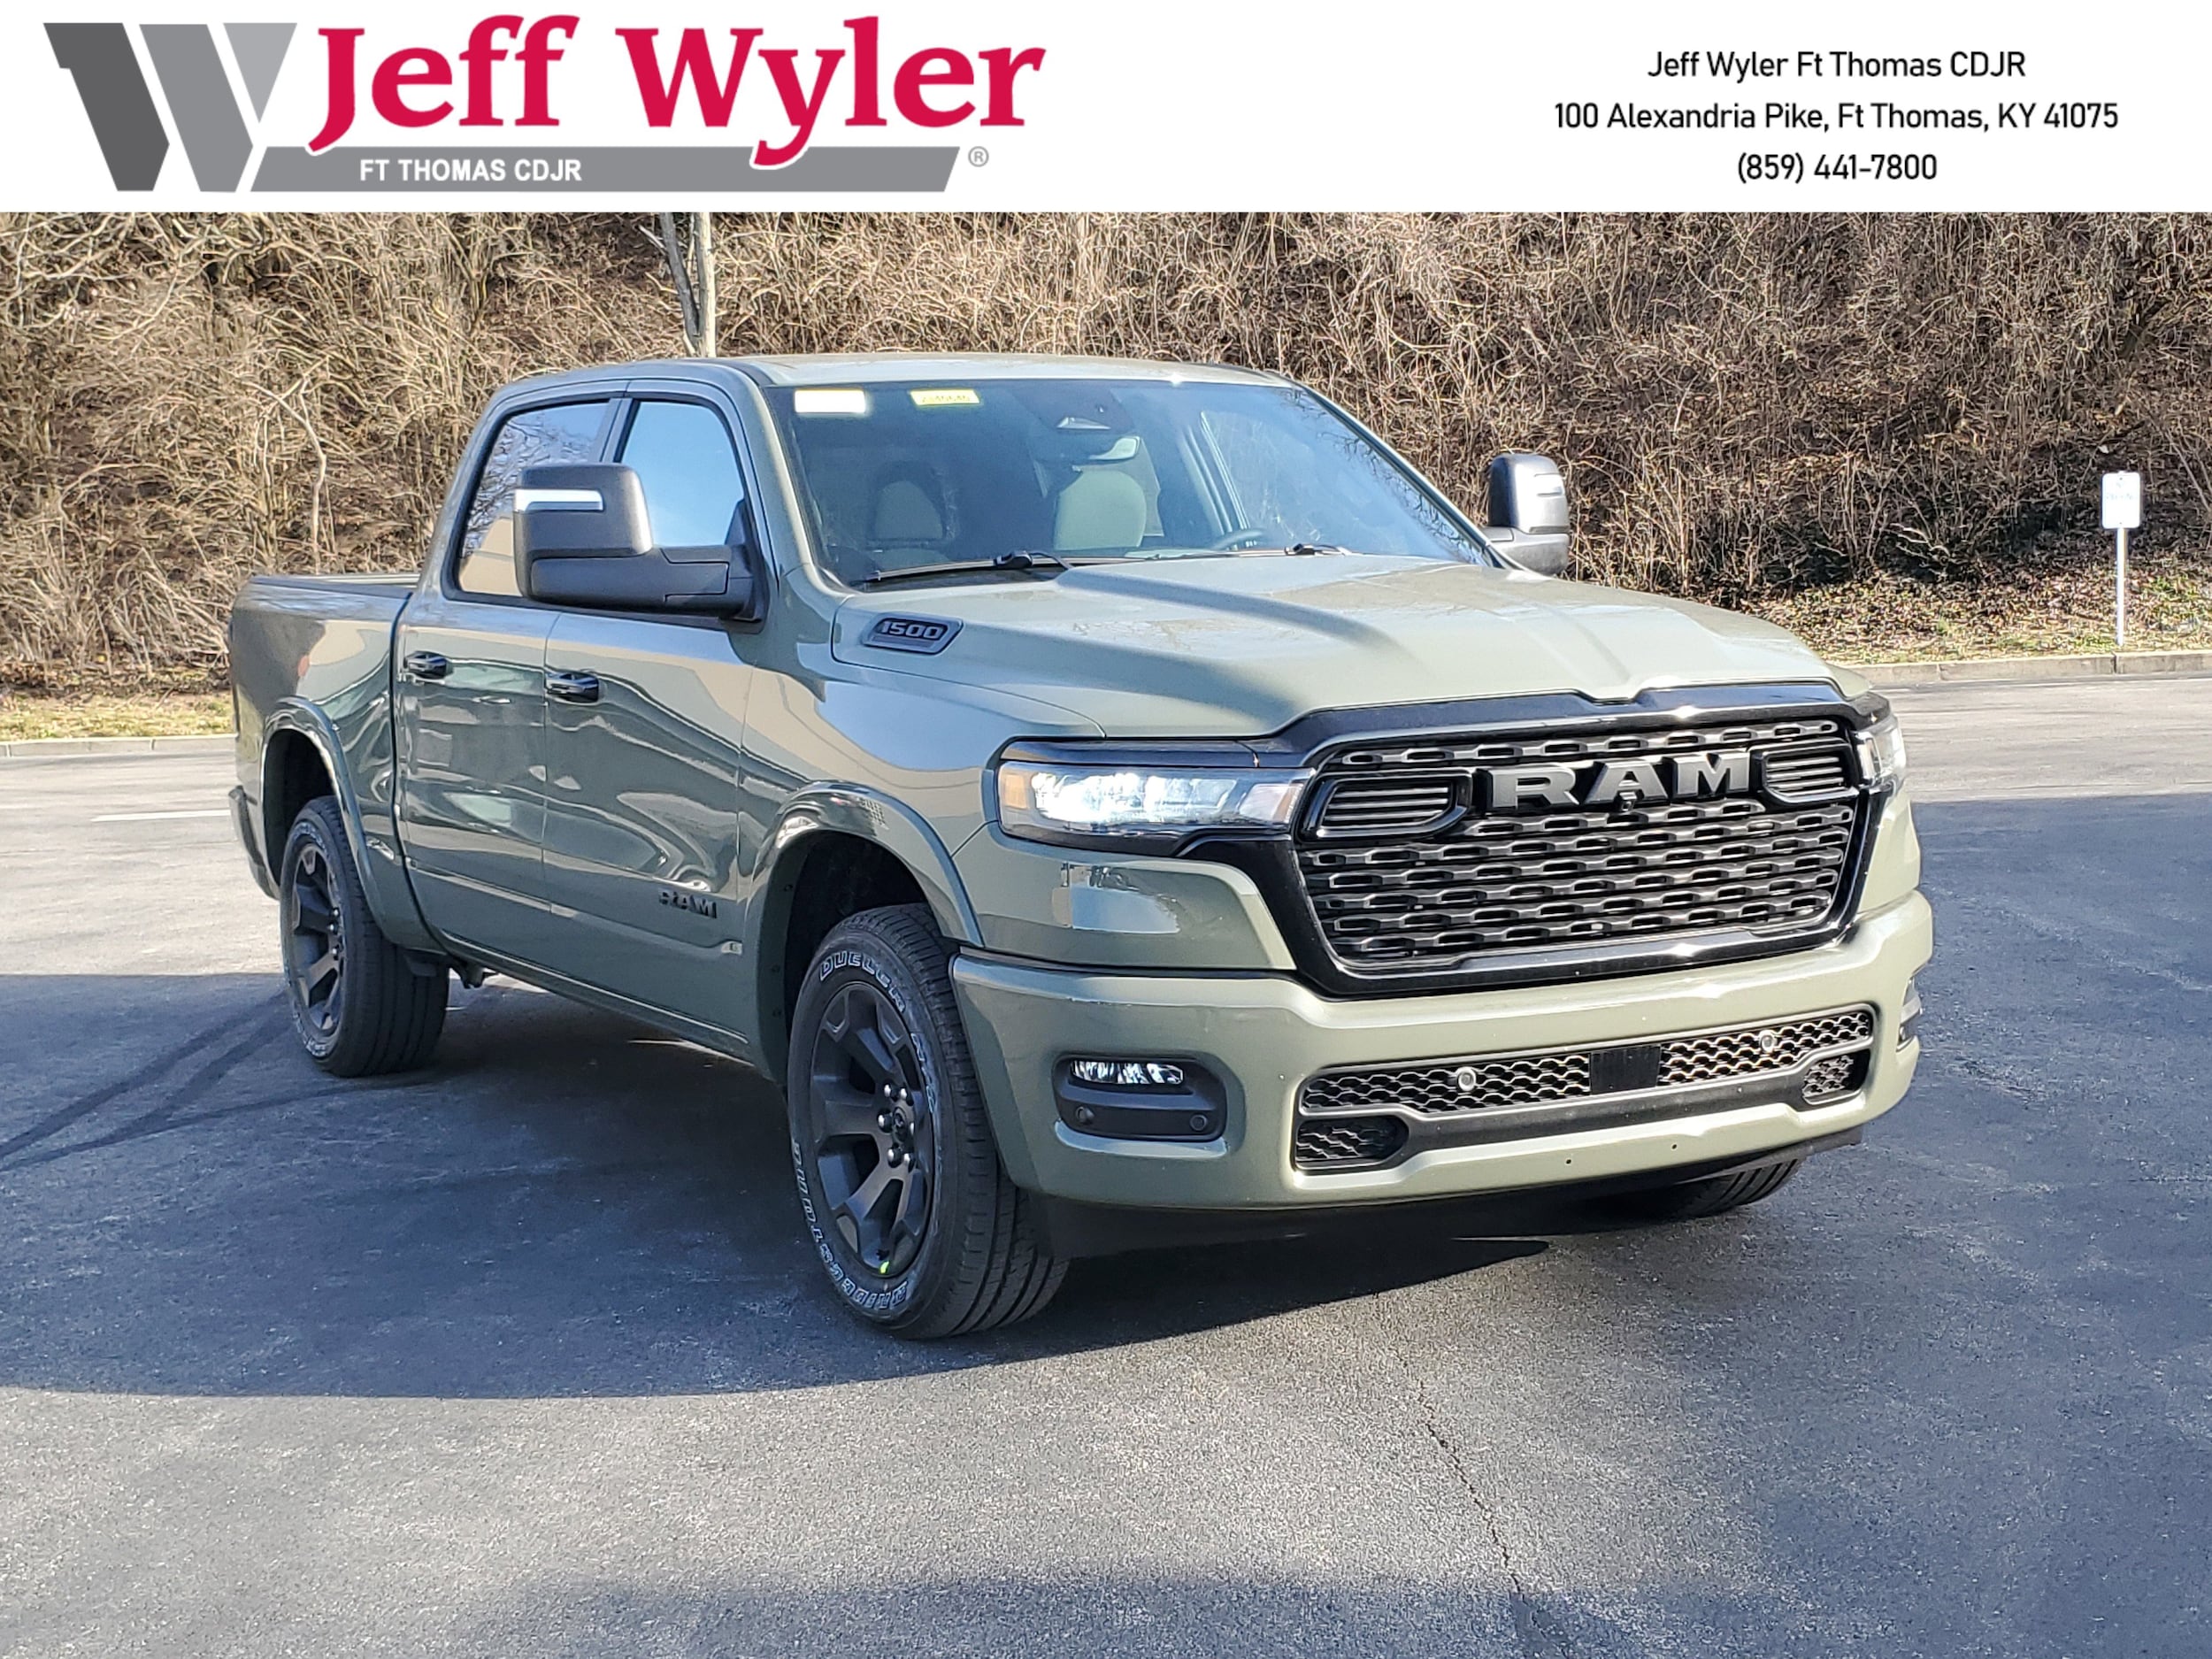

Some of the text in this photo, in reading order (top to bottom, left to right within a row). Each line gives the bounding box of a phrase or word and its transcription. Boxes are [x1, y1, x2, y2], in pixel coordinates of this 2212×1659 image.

[880, 621, 944, 639] 1500
[1485, 749, 1752, 810] RAM
[658, 889, 718, 918] RAM
[819, 950, 907, 1014] DUELER
